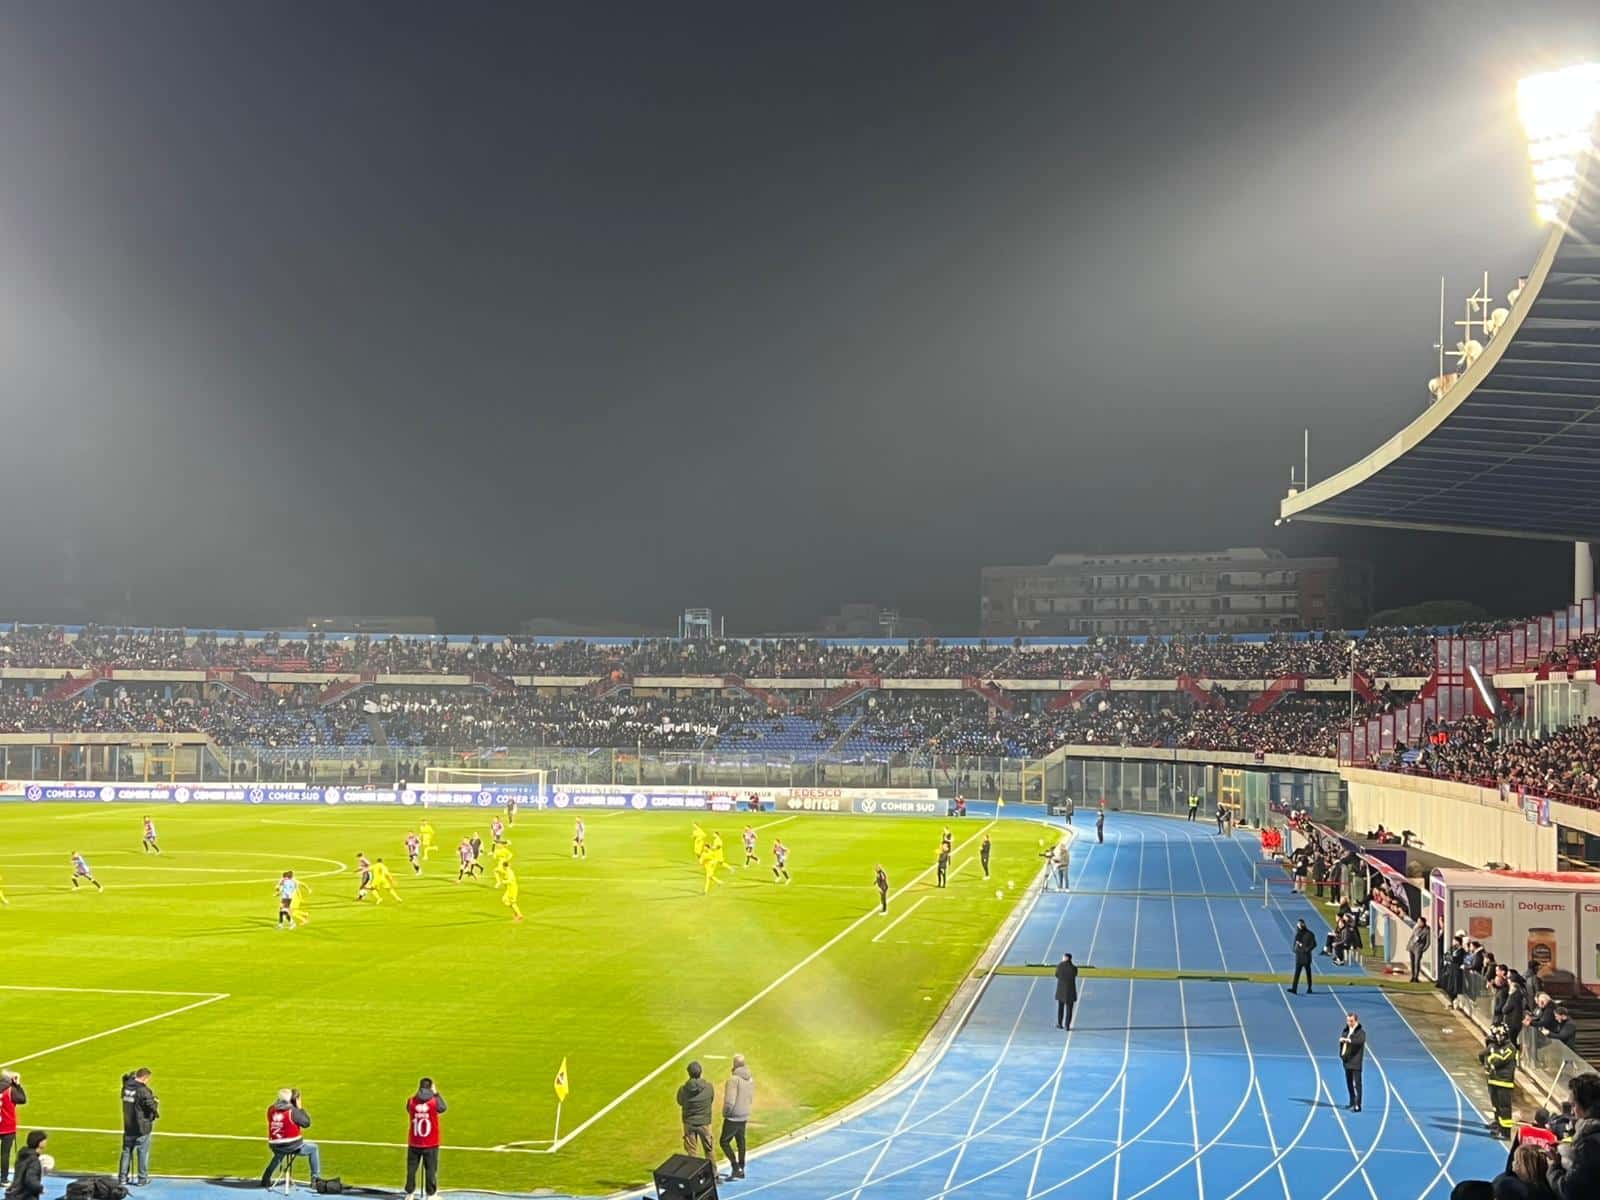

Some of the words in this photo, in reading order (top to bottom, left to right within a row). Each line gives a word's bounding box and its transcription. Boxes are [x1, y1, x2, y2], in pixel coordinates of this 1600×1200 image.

[46, 790, 76, 798] COMER
[78, 790, 96, 799] SUD
[268, 791, 300, 800] COMER
[301, 791, 320, 801] SUD
[916, 804, 935, 812] SUD
[1463, 900, 1505, 909] Siciliani
[412, 1118, 432, 1137] 10
